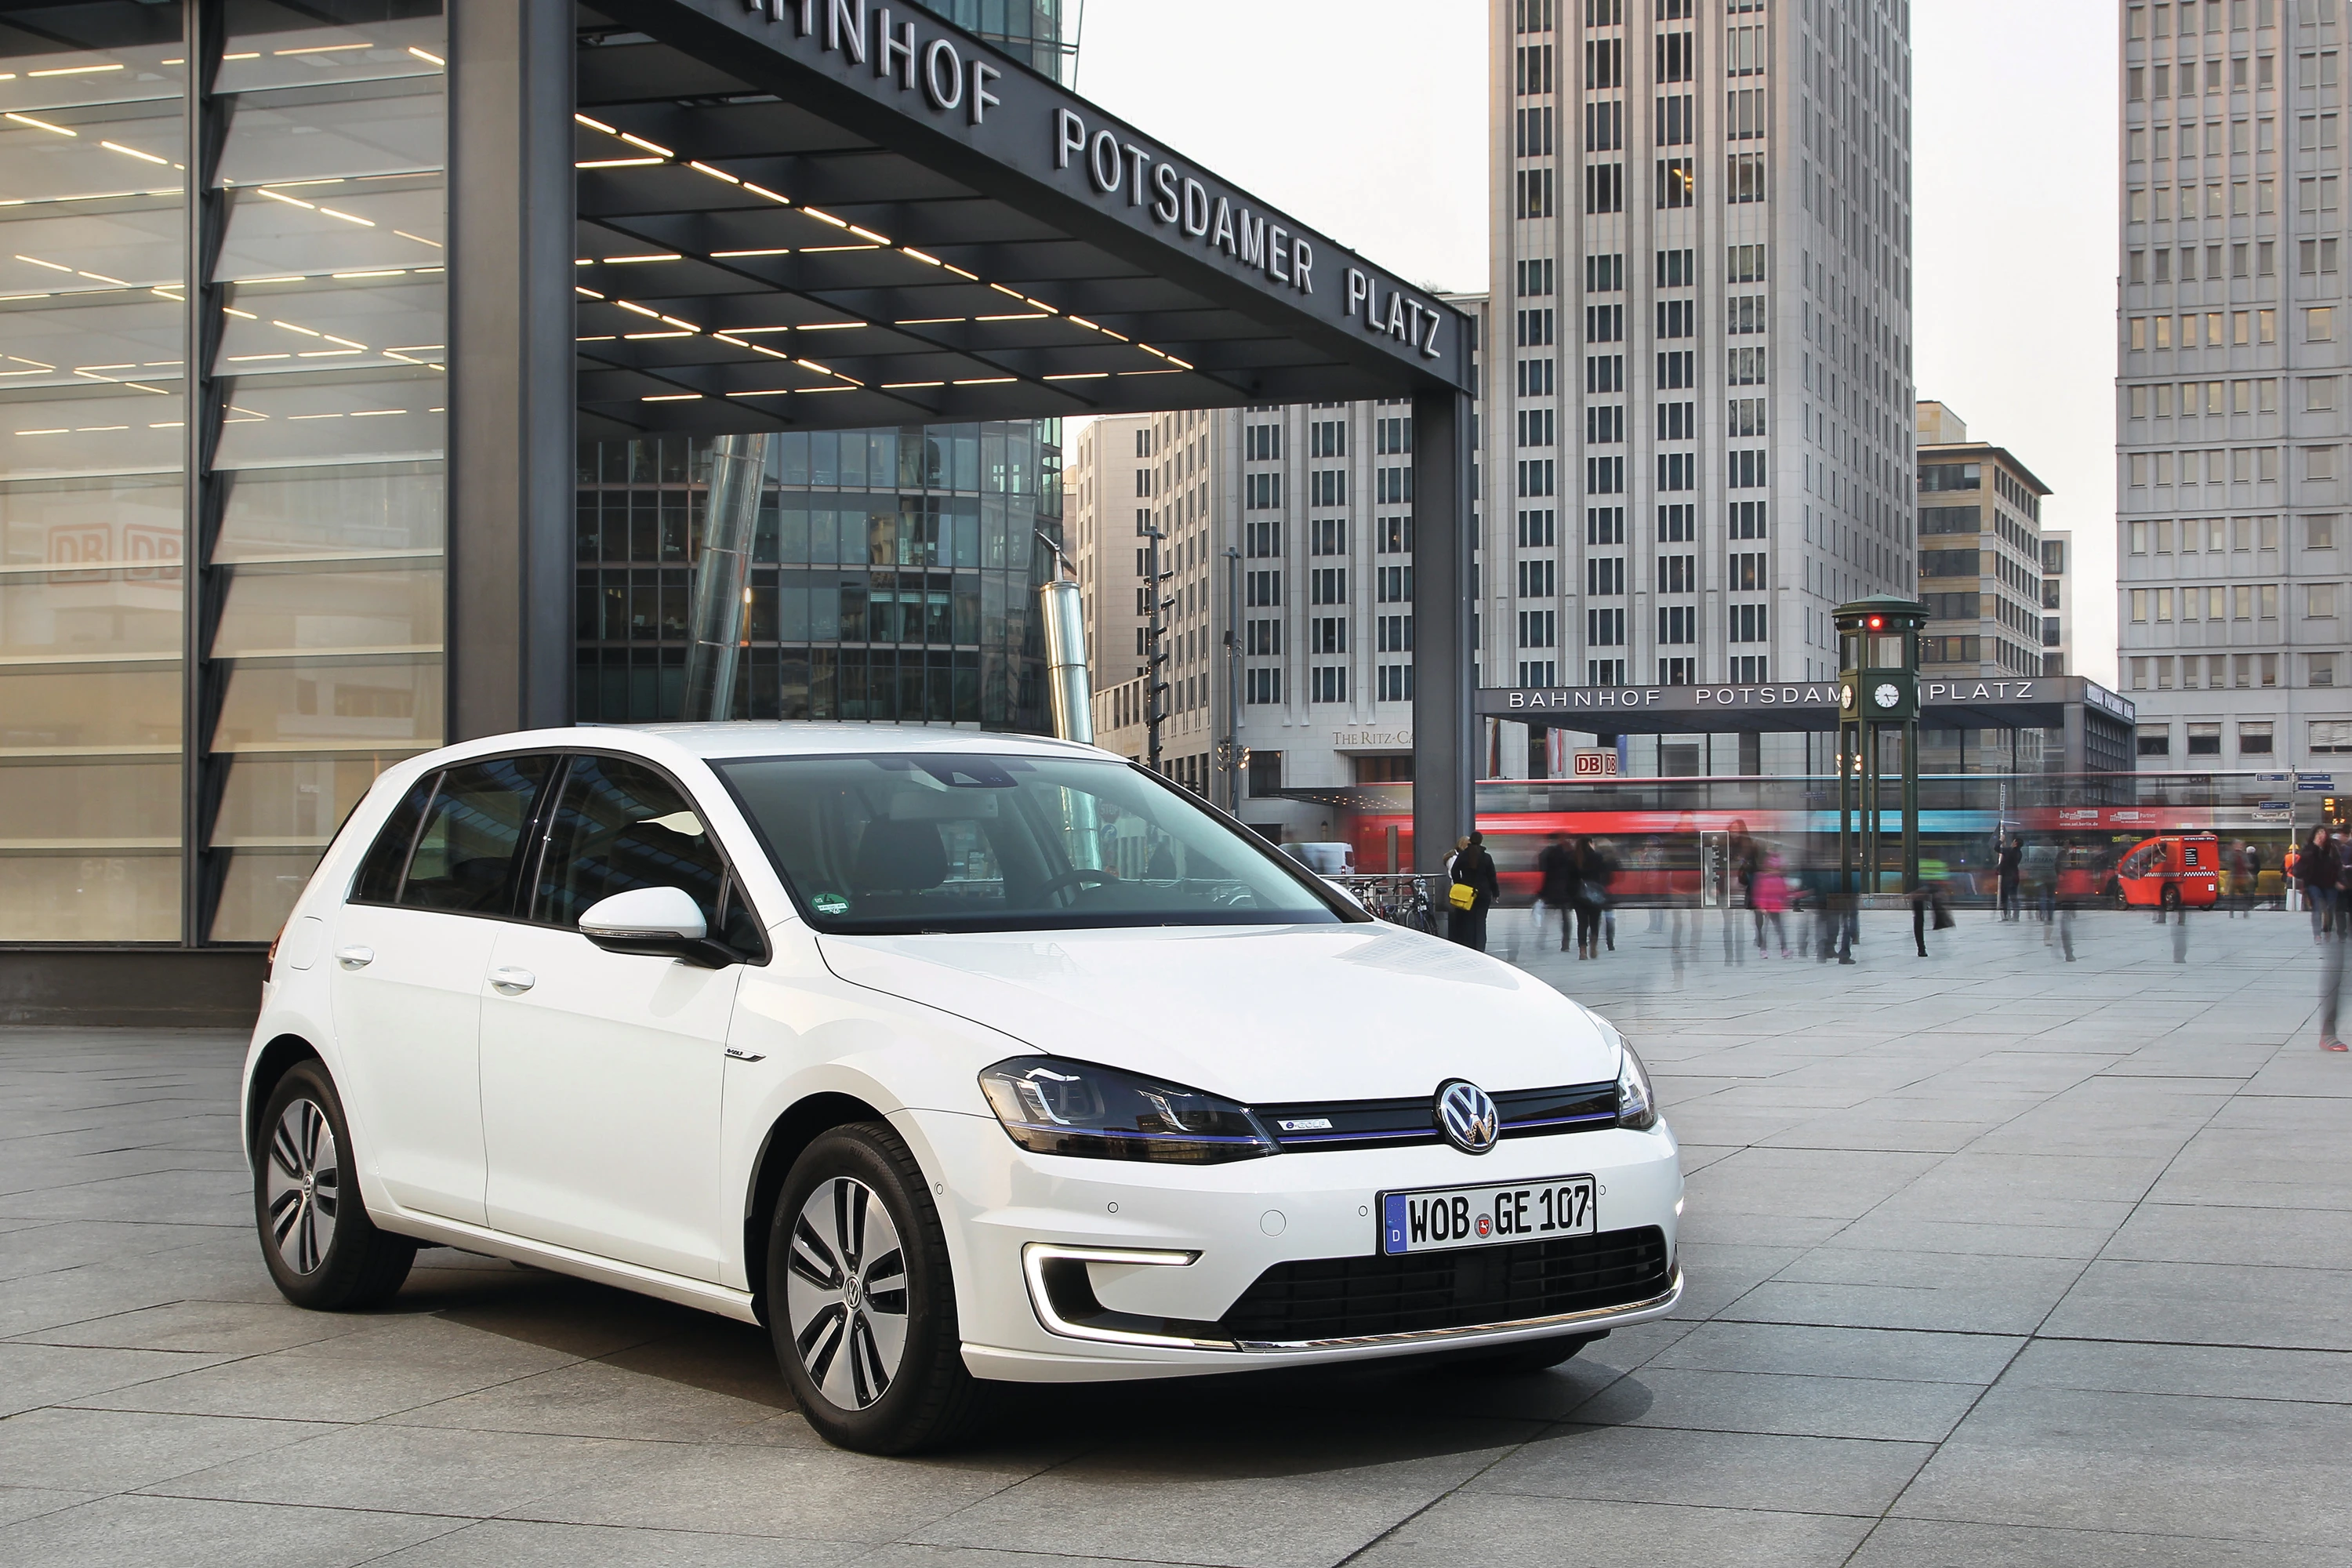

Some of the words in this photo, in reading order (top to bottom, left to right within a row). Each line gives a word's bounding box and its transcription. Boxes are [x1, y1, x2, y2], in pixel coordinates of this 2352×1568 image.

[1054, 107, 1313, 294] POTSDAMER
[1344, 267, 1441, 358] PLATZ
[56, 533, 103, 576] DB
[132, 534, 181, 579] DB
[1508, 689, 1661, 709] BAHNHOF
[1695, 686, 1841, 705] POTSDAM
[1929, 681, 2034, 700] PLATZ
[1333, 731, 1350, 745] THE
[1578, 757, 1599, 771] DB
[1606, 757, 1615, 771] DB
[1100, 804, 1119, 815] STOP
[1409, 1196, 1471, 1243] WOB
[1494, 1190, 1532, 1236] GE
[1539, 1185, 1590, 1231] 107
[1392, 1229, 1400, 1242] D
